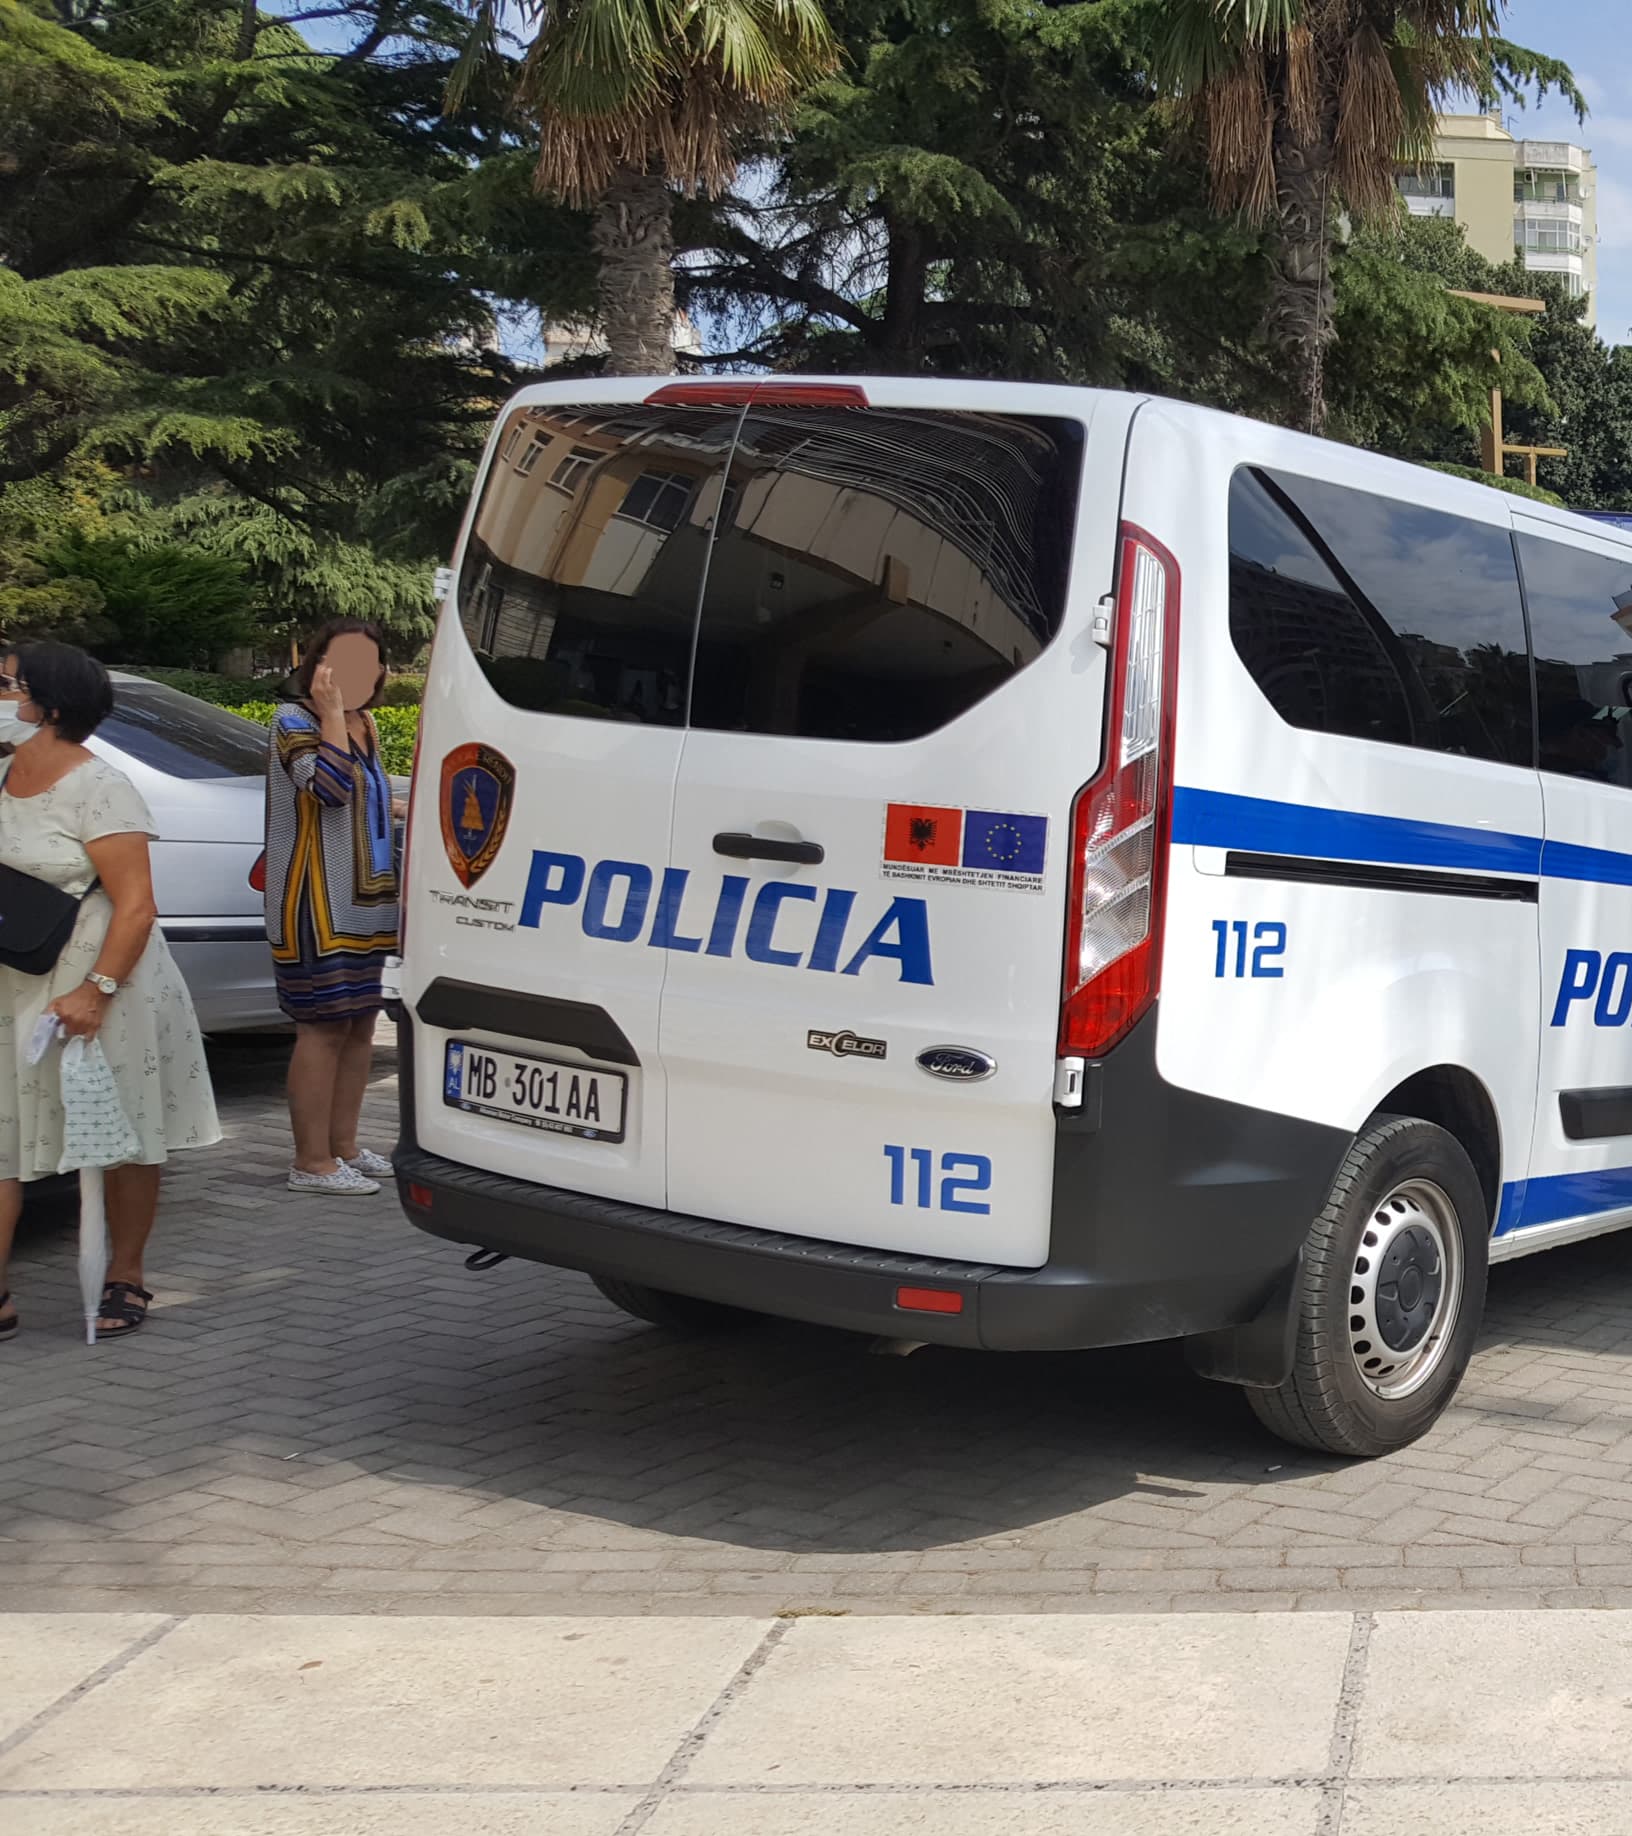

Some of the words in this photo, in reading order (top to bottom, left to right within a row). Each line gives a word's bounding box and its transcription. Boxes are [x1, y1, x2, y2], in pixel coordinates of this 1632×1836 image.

[429, 889, 515, 914] TRANSIT
[517, 849, 936, 986] POLICIA
[1212, 920, 1287, 978] 112
[467, 1053, 498, 1100] MB
[929, 1052, 977, 1075] Ford
[882, 1144, 991, 1216] 112
